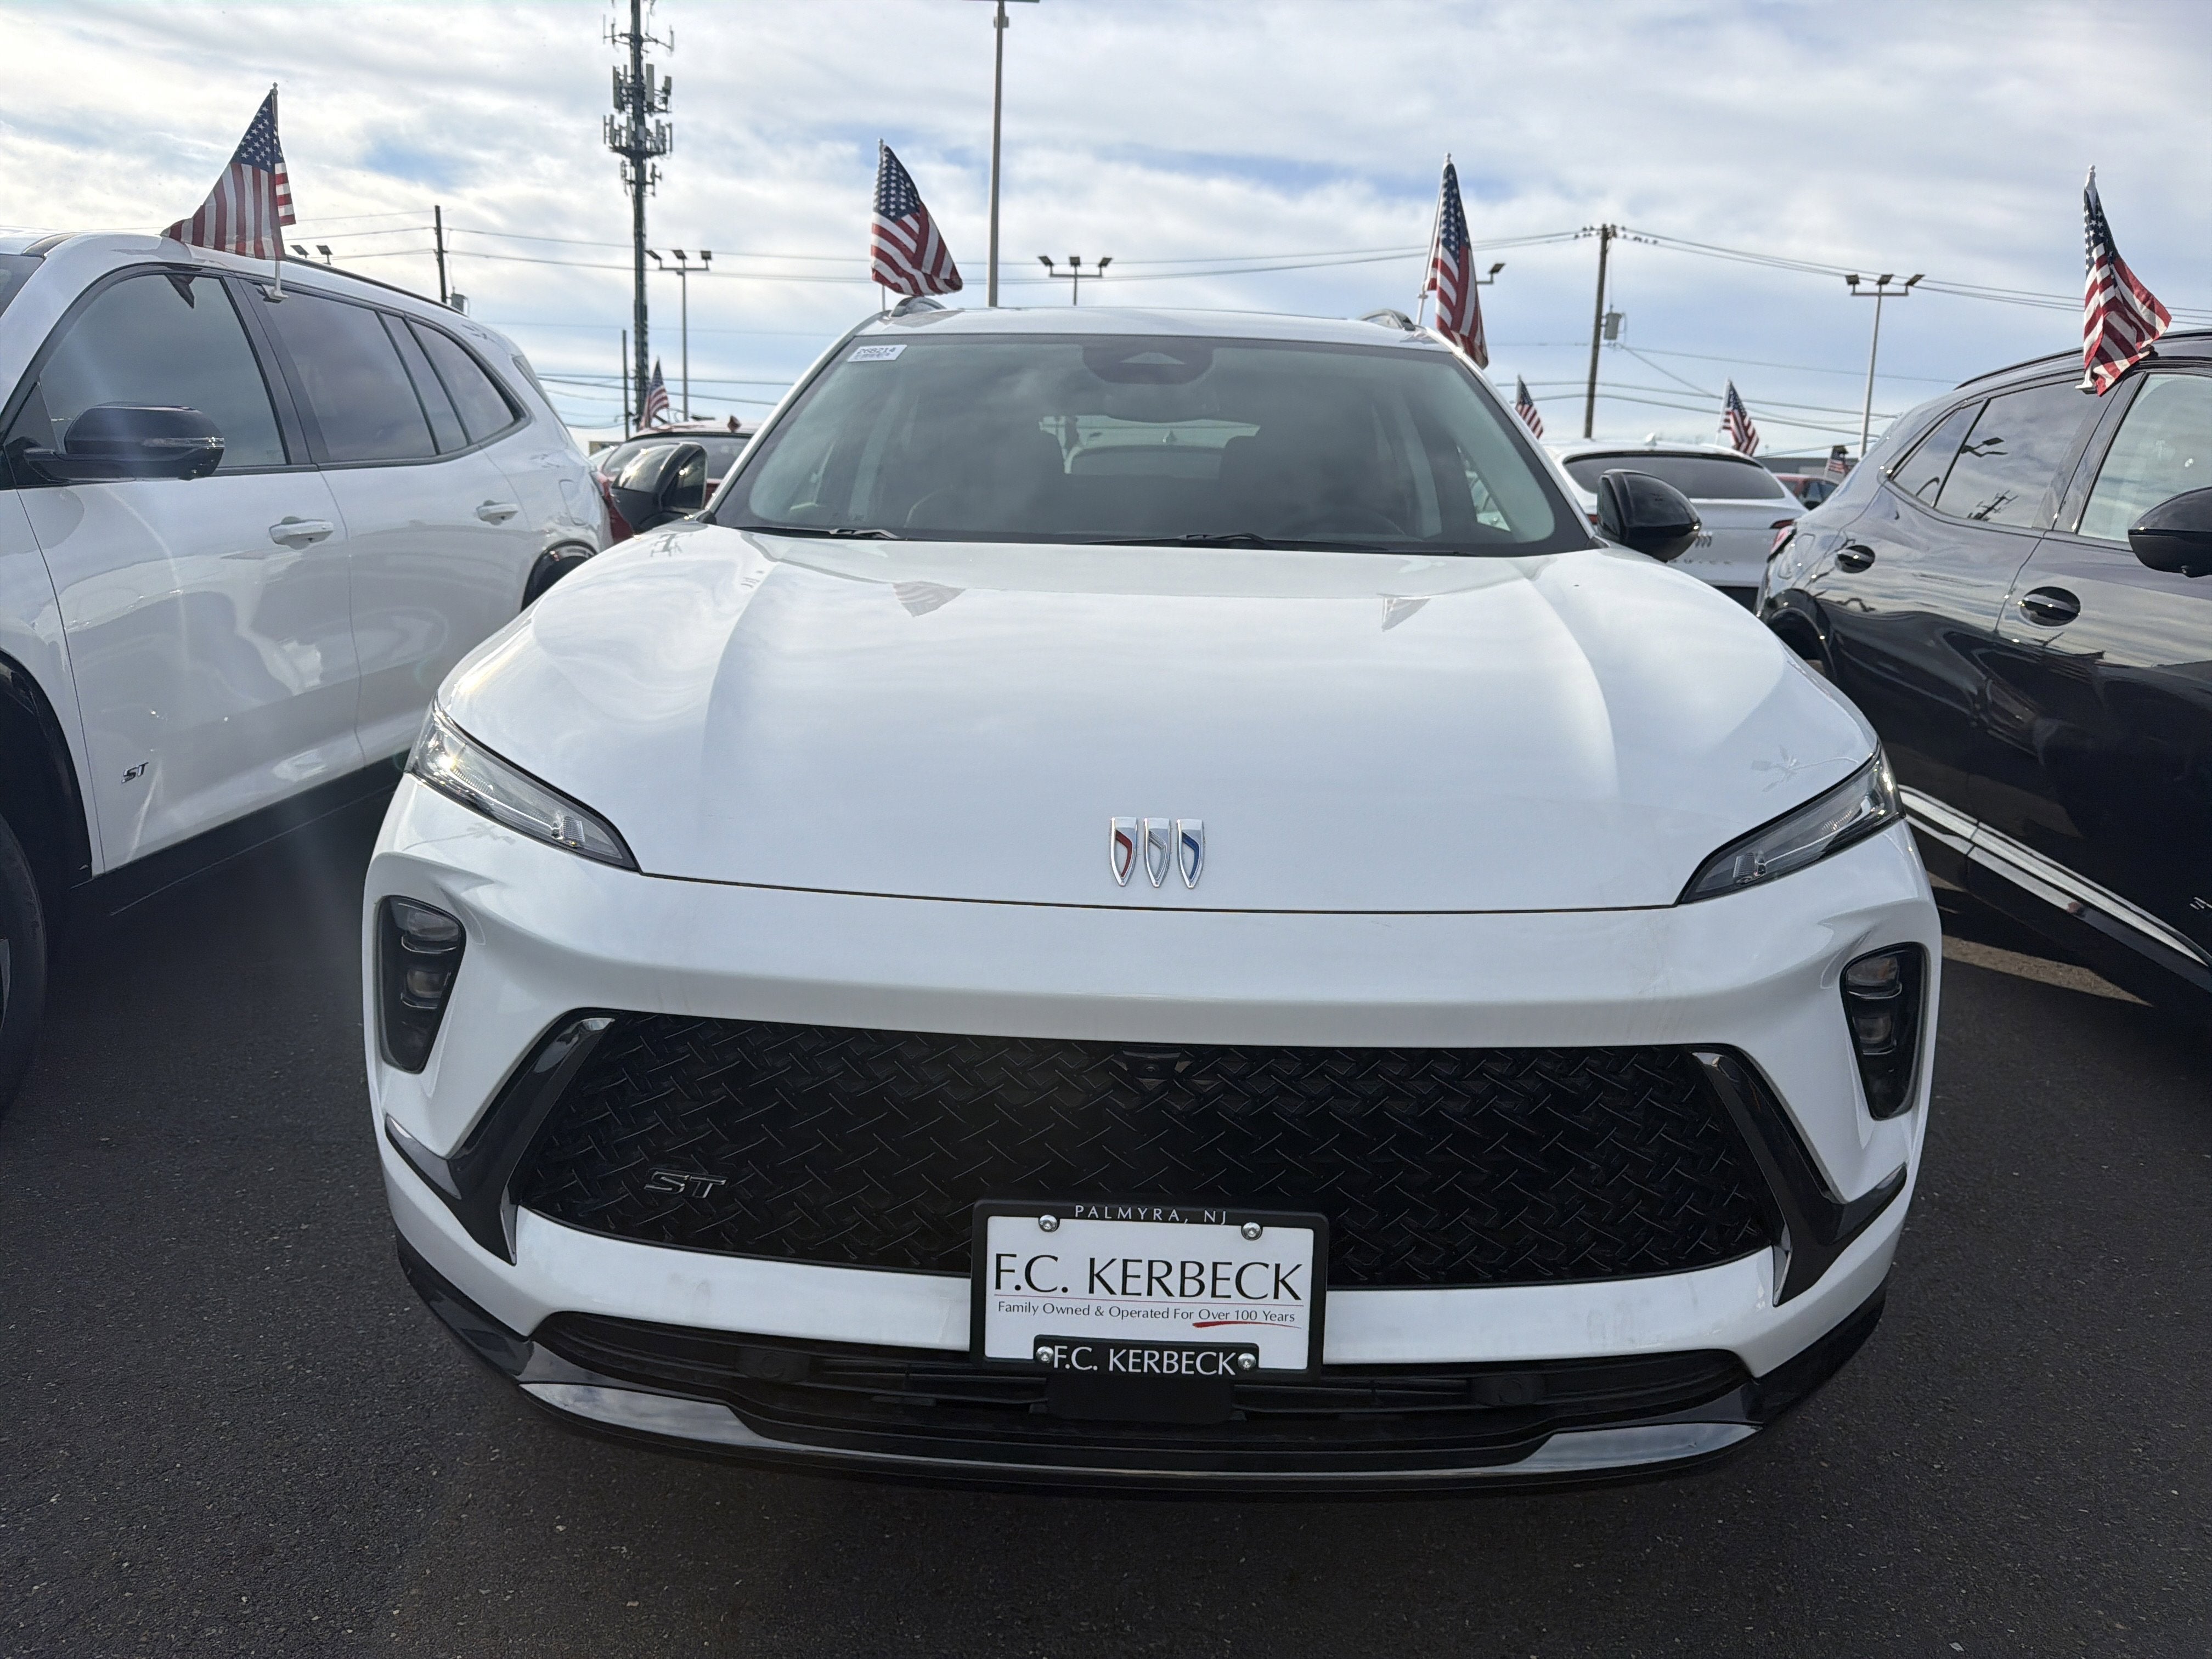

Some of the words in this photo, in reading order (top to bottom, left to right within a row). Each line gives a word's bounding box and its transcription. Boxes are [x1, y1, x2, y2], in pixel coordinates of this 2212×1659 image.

[122, 761, 149, 783] ST
[644, 1171, 727, 1198] ST
[1075, 1205, 1189, 1224] PALMYRA,
[1204, 1210, 1227, 1225] NJ
[995, 1253, 1069, 1293] F.C.
[1088, 1257, 1303, 1301] KERBECK
[998, 1301, 1039, 1316] Family
[1042, 1302, 1091, 1316] Owned
[1094, 1305, 1105, 1317] &
[1108, 1305, 1170, 1321] Operated
[1173, 1308, 1194, 1319] For
[1198, 1308, 1231, 1321] Over
[1235, 1310, 1258, 1321] 100
[1262, 1310, 1295, 1322] Years
[1053, 1345, 1098, 1371] F.C.
[1109, 1348, 1237, 1376] KERBECK
